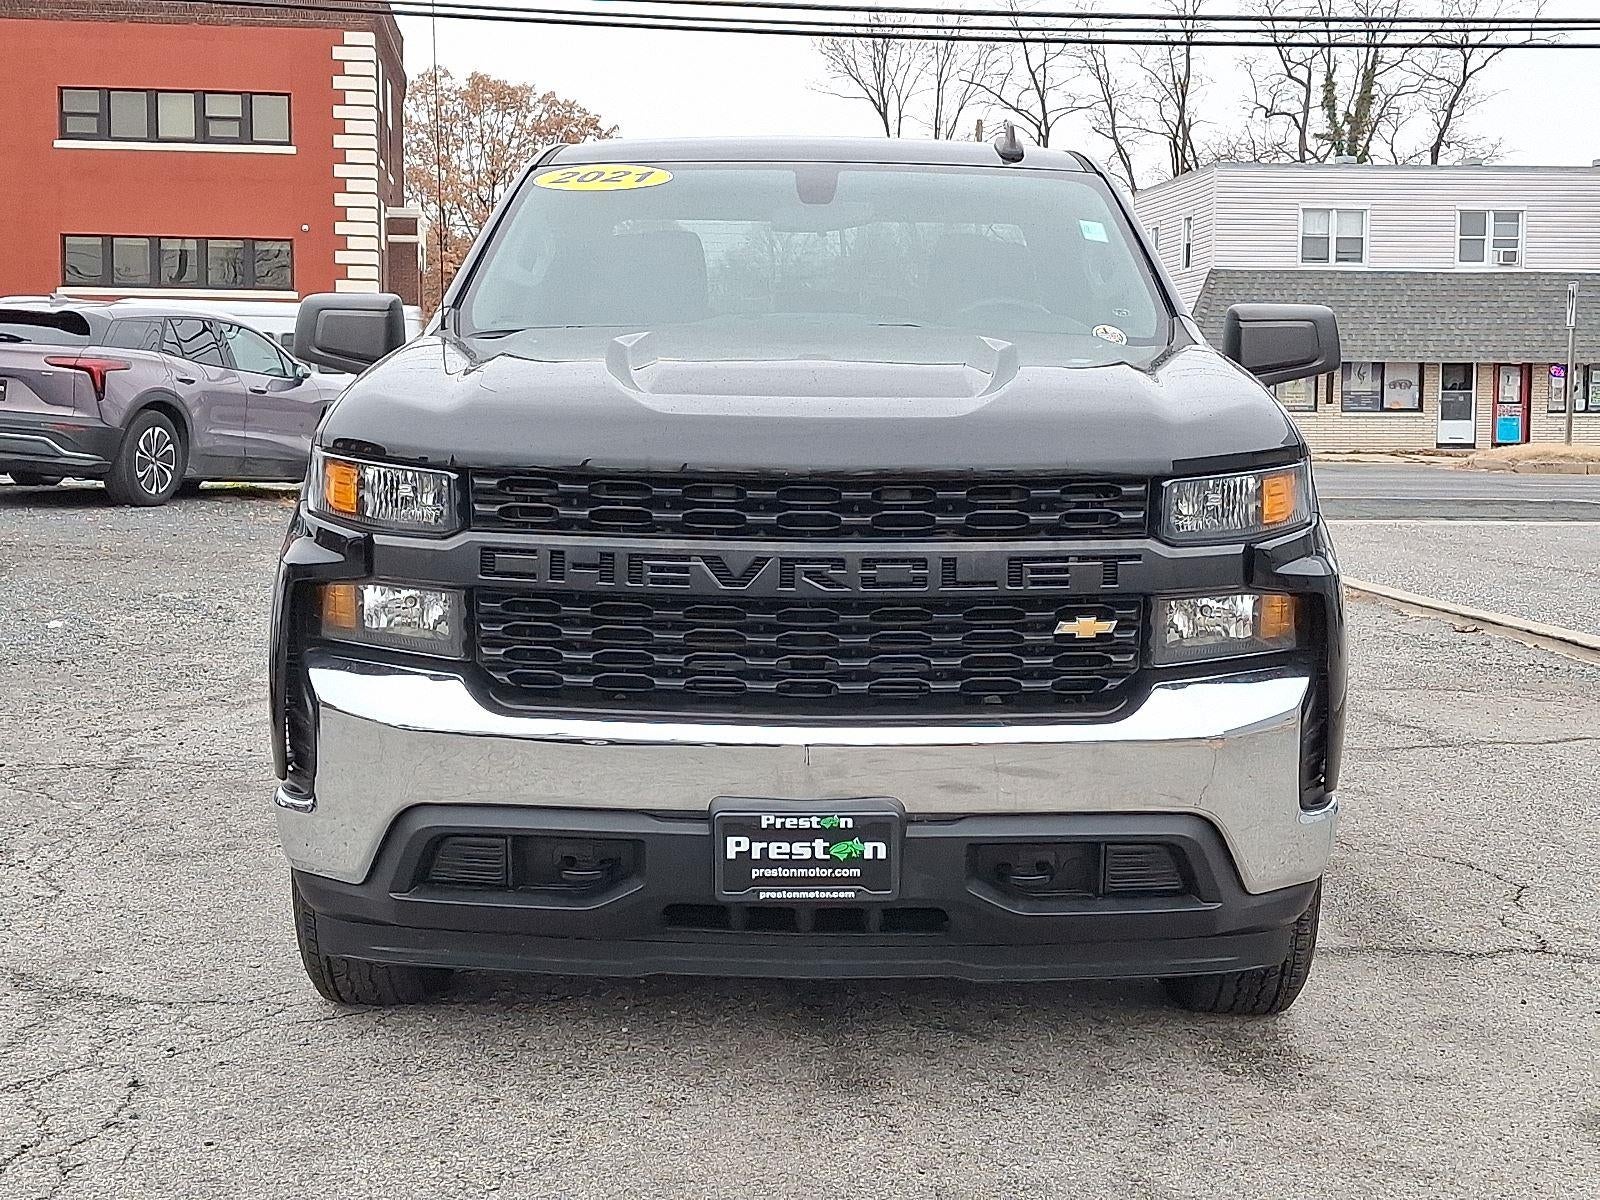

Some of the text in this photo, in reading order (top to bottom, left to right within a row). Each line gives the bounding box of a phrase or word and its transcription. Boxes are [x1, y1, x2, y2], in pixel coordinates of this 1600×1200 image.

[549, 170, 655, 184] 2021
[479, 546, 1142, 590] CHEVROLET
[752, 867, 861, 880] prestonmotor.com
[759, 890, 855, 900] prestonmotor.com
